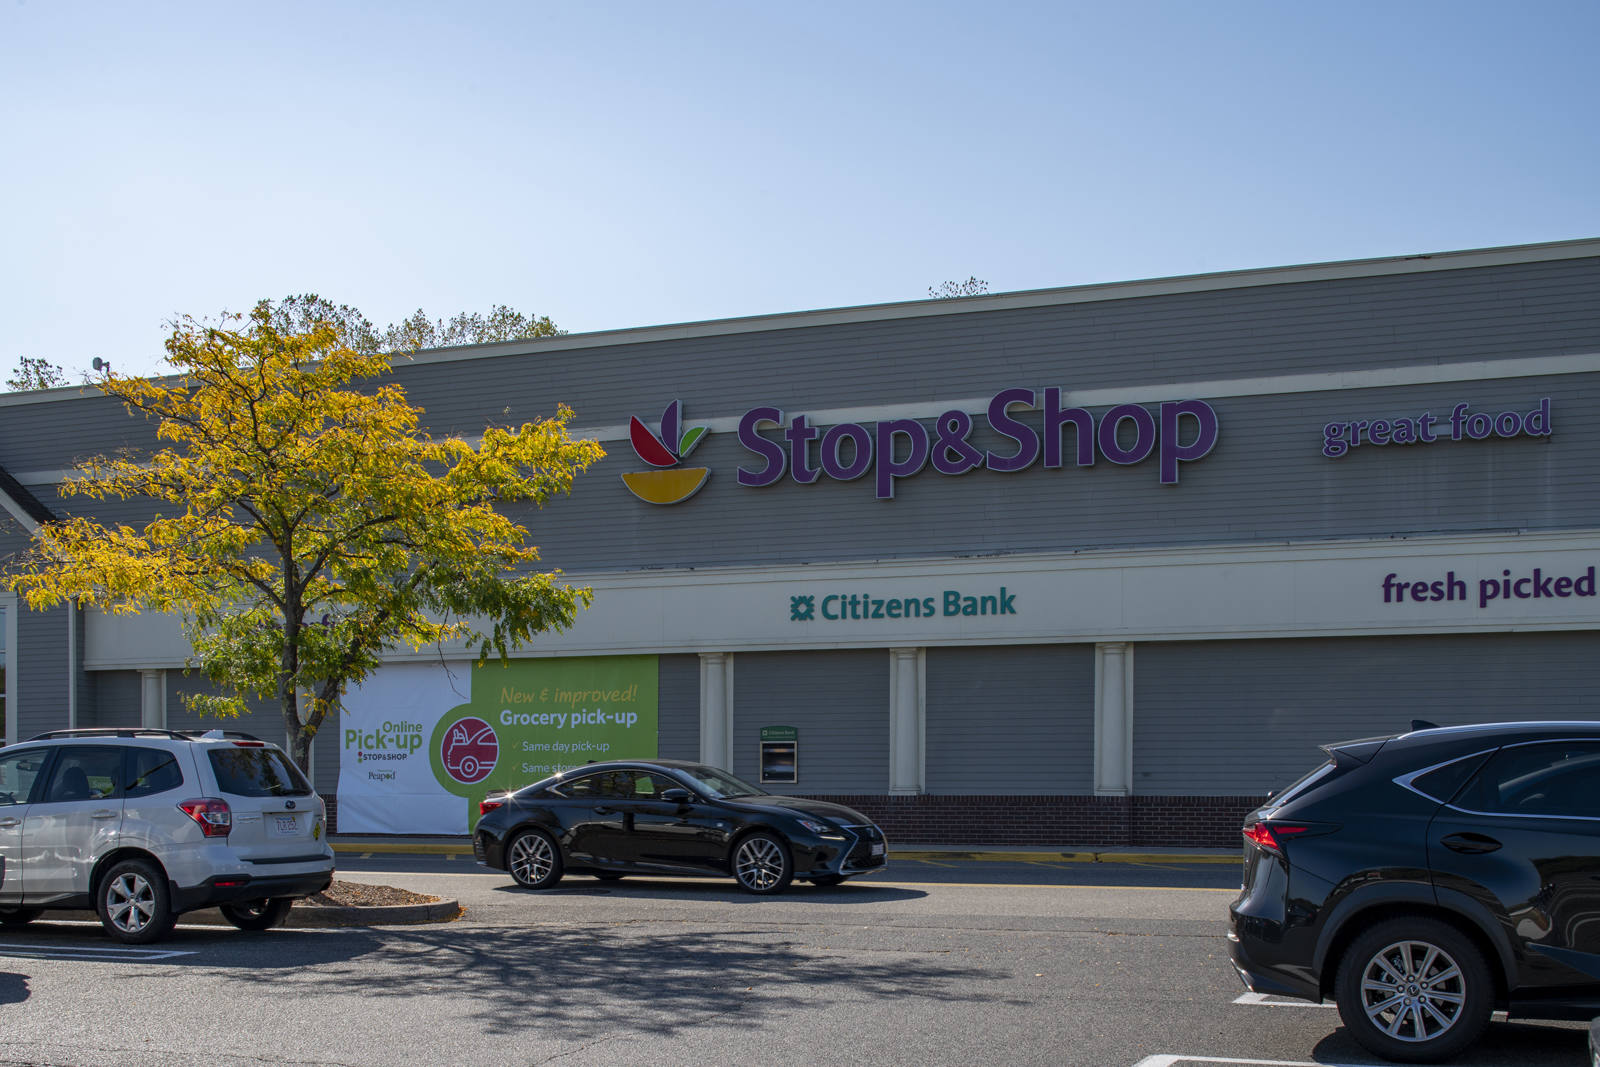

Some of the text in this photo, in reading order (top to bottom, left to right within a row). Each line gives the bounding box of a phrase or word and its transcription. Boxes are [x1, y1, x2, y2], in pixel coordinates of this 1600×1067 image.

[1322, 397, 1552, 457] great food
[737, 387, 1219, 499] Stop&Shop
[1382, 566, 1597, 608] fresh picked
[821, 587, 1017, 620] Citizens Bank
[500, 687, 535, 704] New
[382, 721, 423, 733] Online
[500, 708, 638, 729] Grocery pick-up
[345, 729, 423, 755] Pick-up
[522, 741, 610, 754] Same day pick-up
[363, 753, 407, 761] STOP&SHOP
[522, 763, 550, 773] Same
